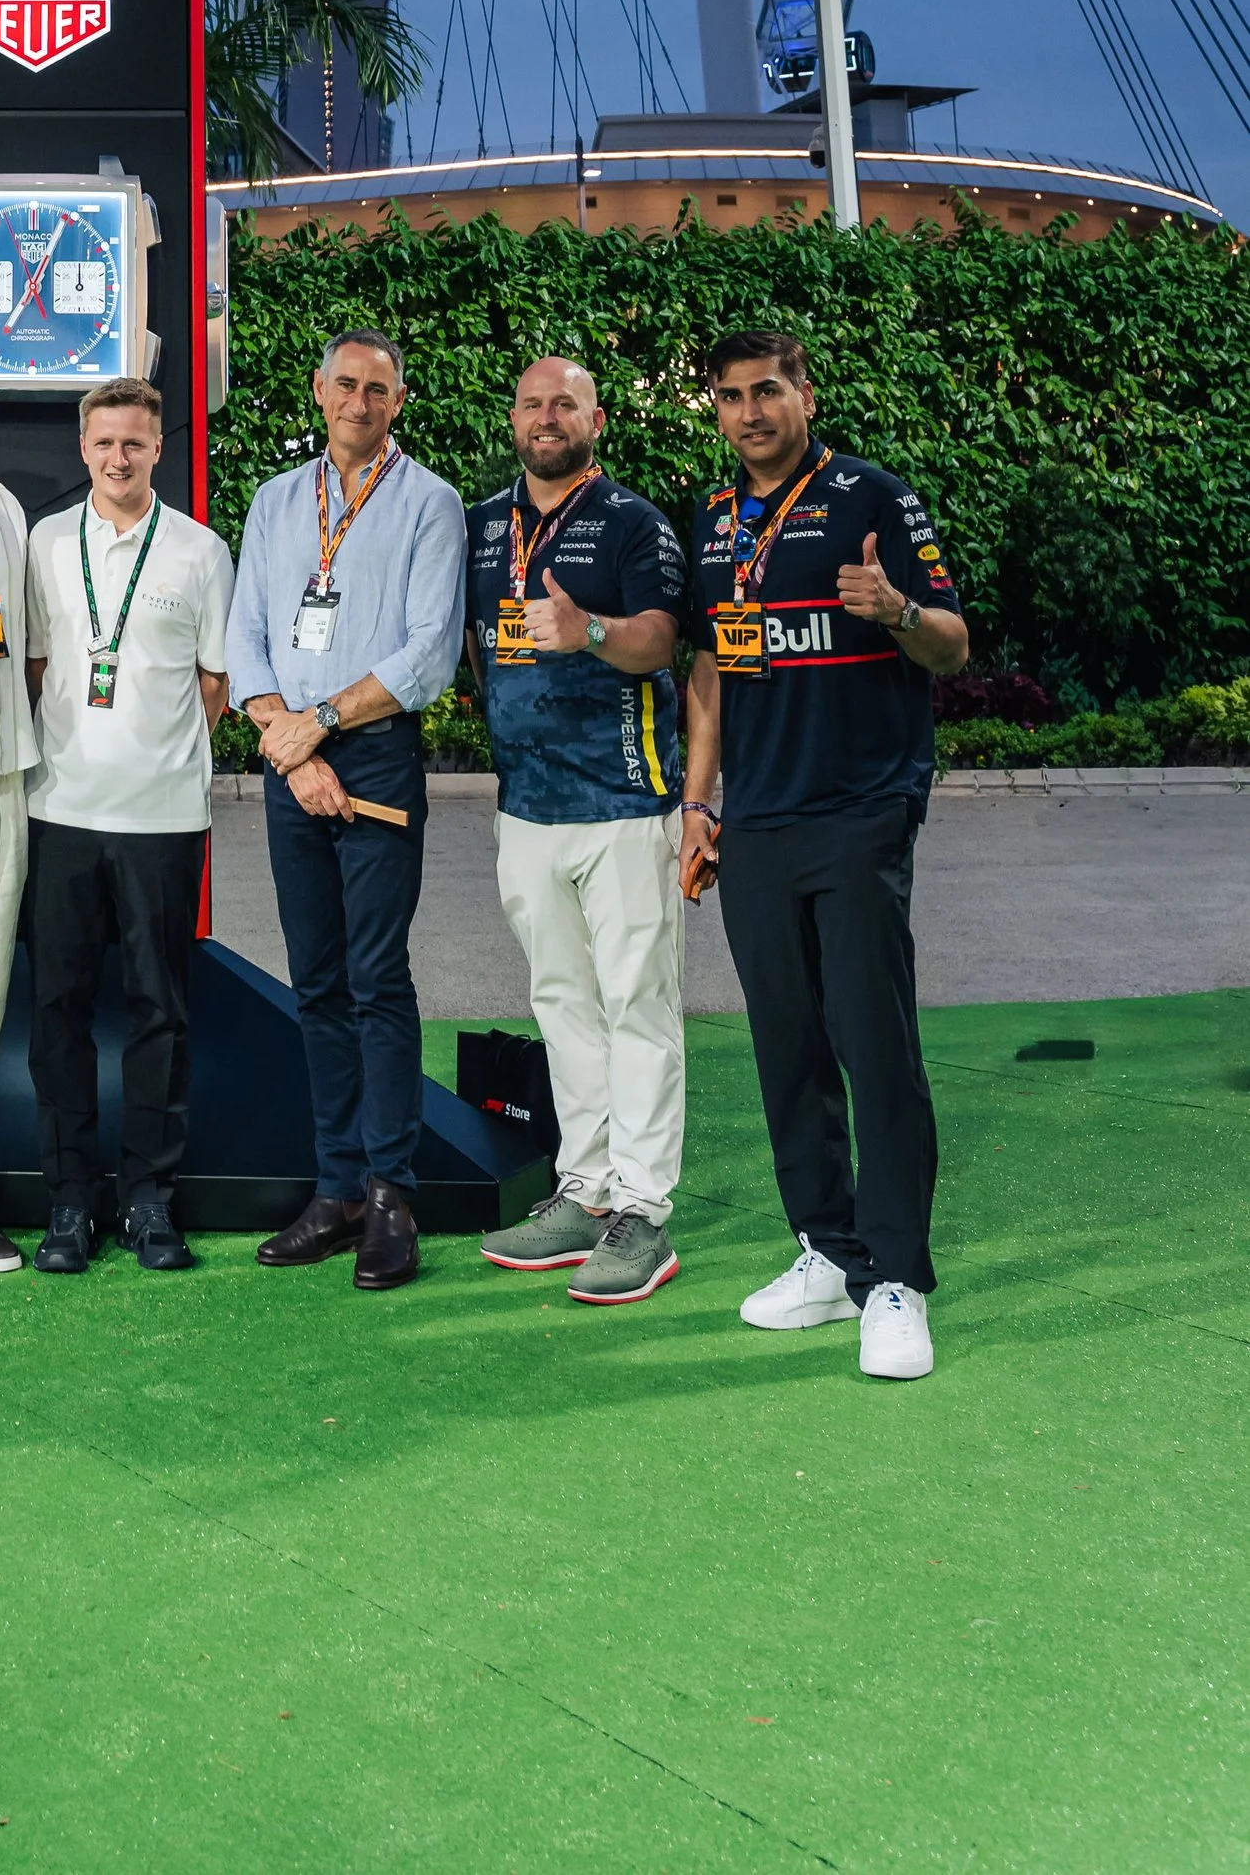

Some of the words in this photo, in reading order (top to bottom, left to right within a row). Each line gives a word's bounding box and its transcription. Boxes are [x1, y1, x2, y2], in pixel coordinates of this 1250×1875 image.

[14, 233, 53, 241] MONACO
[23, 242, 44, 251] TAG
[895, 494, 921, 508] VISA
[488, 522, 505, 530] TAG
[783, 530, 825, 540] HONDA
[703, 540, 725, 553] Mobil
[562, 555, 594, 564] Gate.io
[701, 555, 732, 565] ORACLE
[476, 619, 499, 648] Re
[722, 628, 759, 647] VIP
[766, 612, 832, 653] Bull
[621, 688, 646, 789] HYPEBEAST
[505, 1103, 531, 1121] Store
